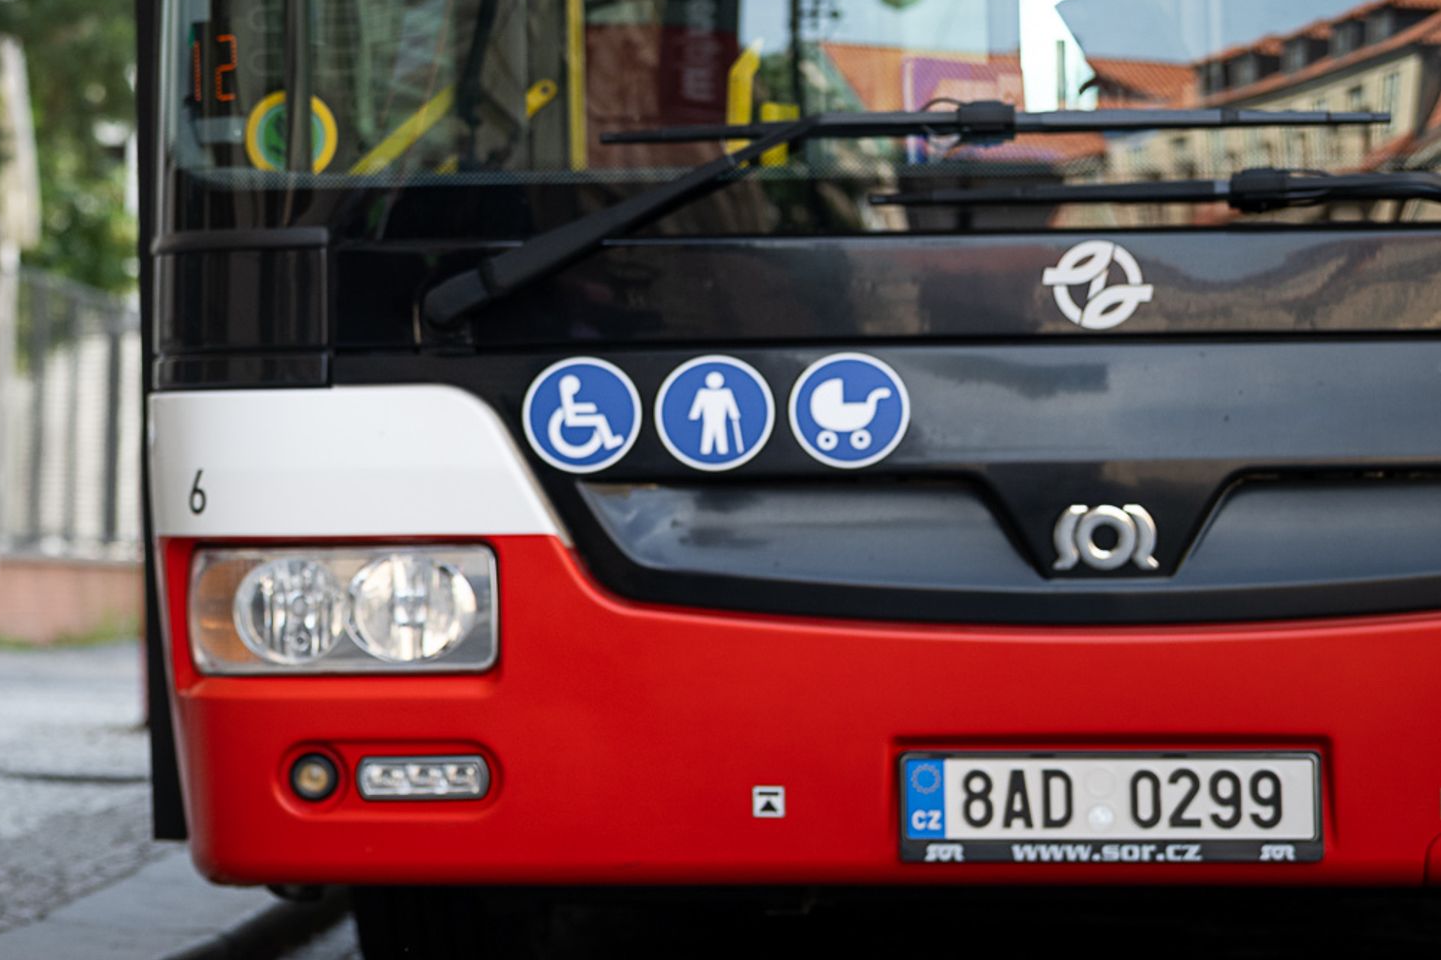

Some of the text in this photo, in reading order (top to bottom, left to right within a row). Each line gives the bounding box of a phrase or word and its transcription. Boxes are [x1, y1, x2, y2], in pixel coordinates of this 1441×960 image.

[189, 469, 207, 515] 6
[911, 768, 1283, 831] CZ 8AD 0299
[1011, 843, 1202, 862] www.sor.cz
